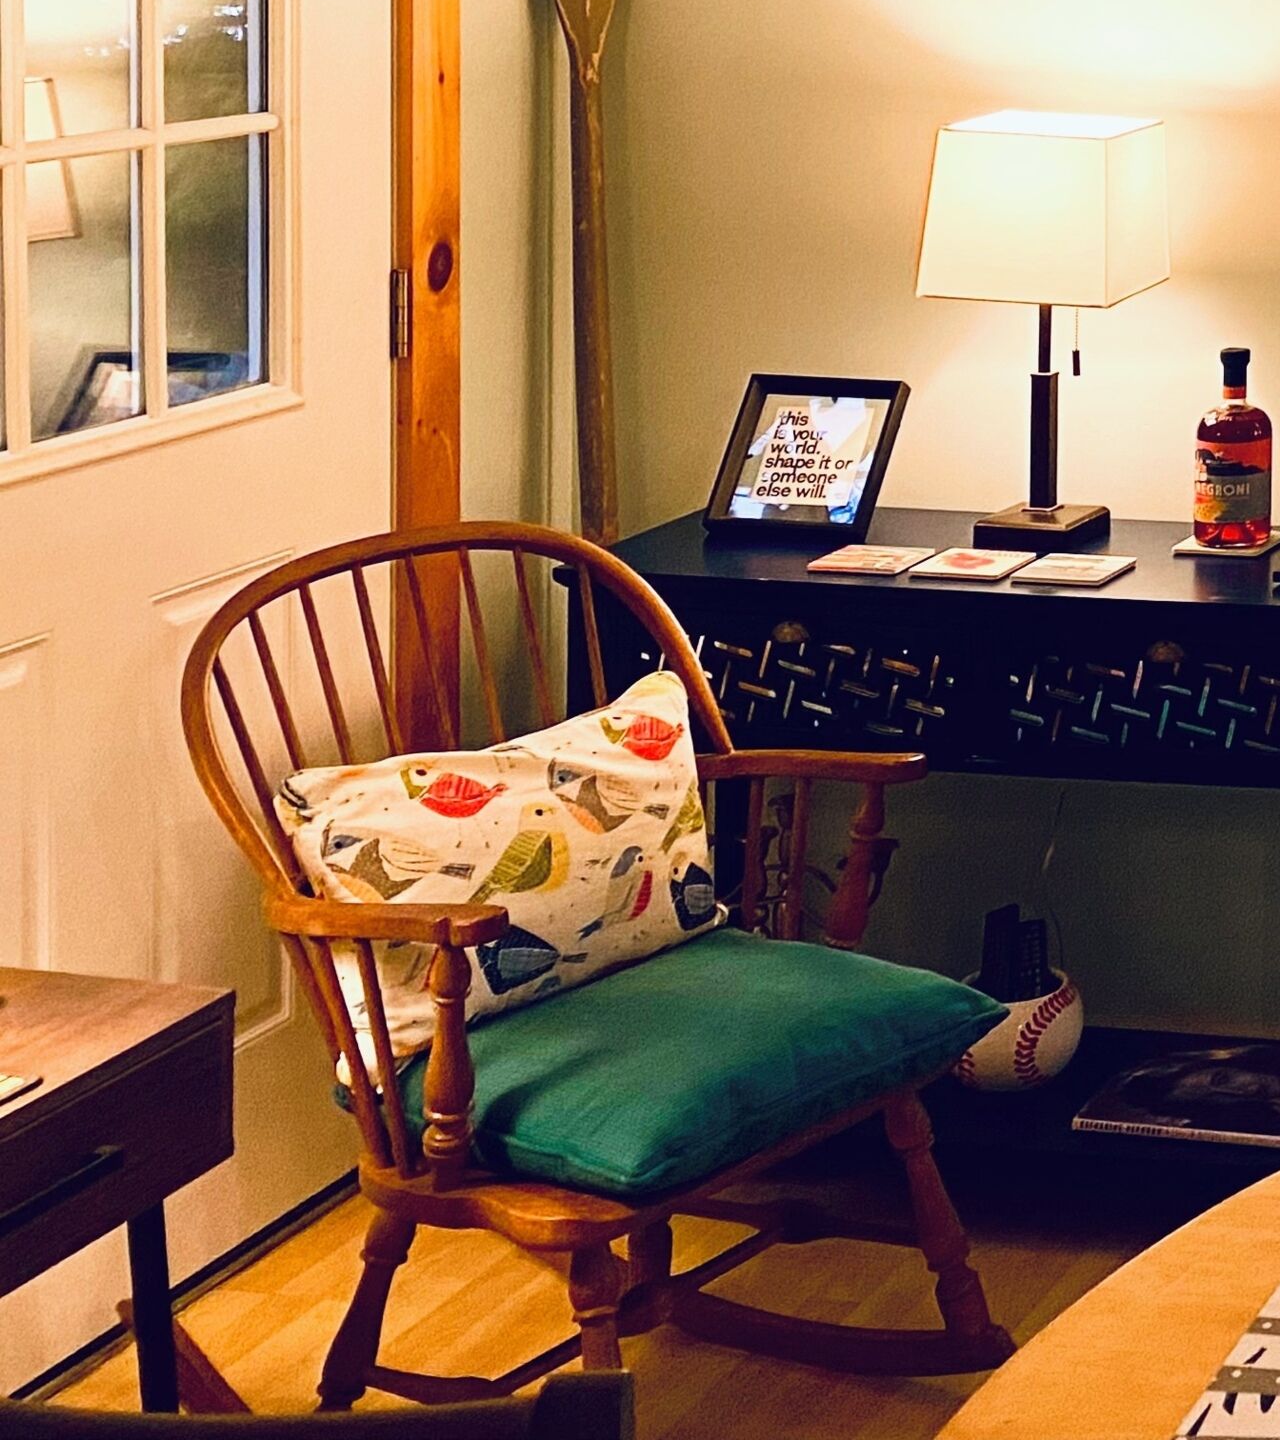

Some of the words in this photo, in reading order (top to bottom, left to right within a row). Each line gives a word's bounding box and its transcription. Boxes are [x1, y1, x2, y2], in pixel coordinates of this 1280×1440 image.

[779, 410, 809, 426] this
[771, 441, 821, 455] world.
[765, 454, 815, 473] shape
[819, 455, 832, 469] it
[834, 459, 854, 470] or
[761, 472, 838, 484] someone
[756, 483, 791, 497] else
[796, 484, 827, 498] will.
